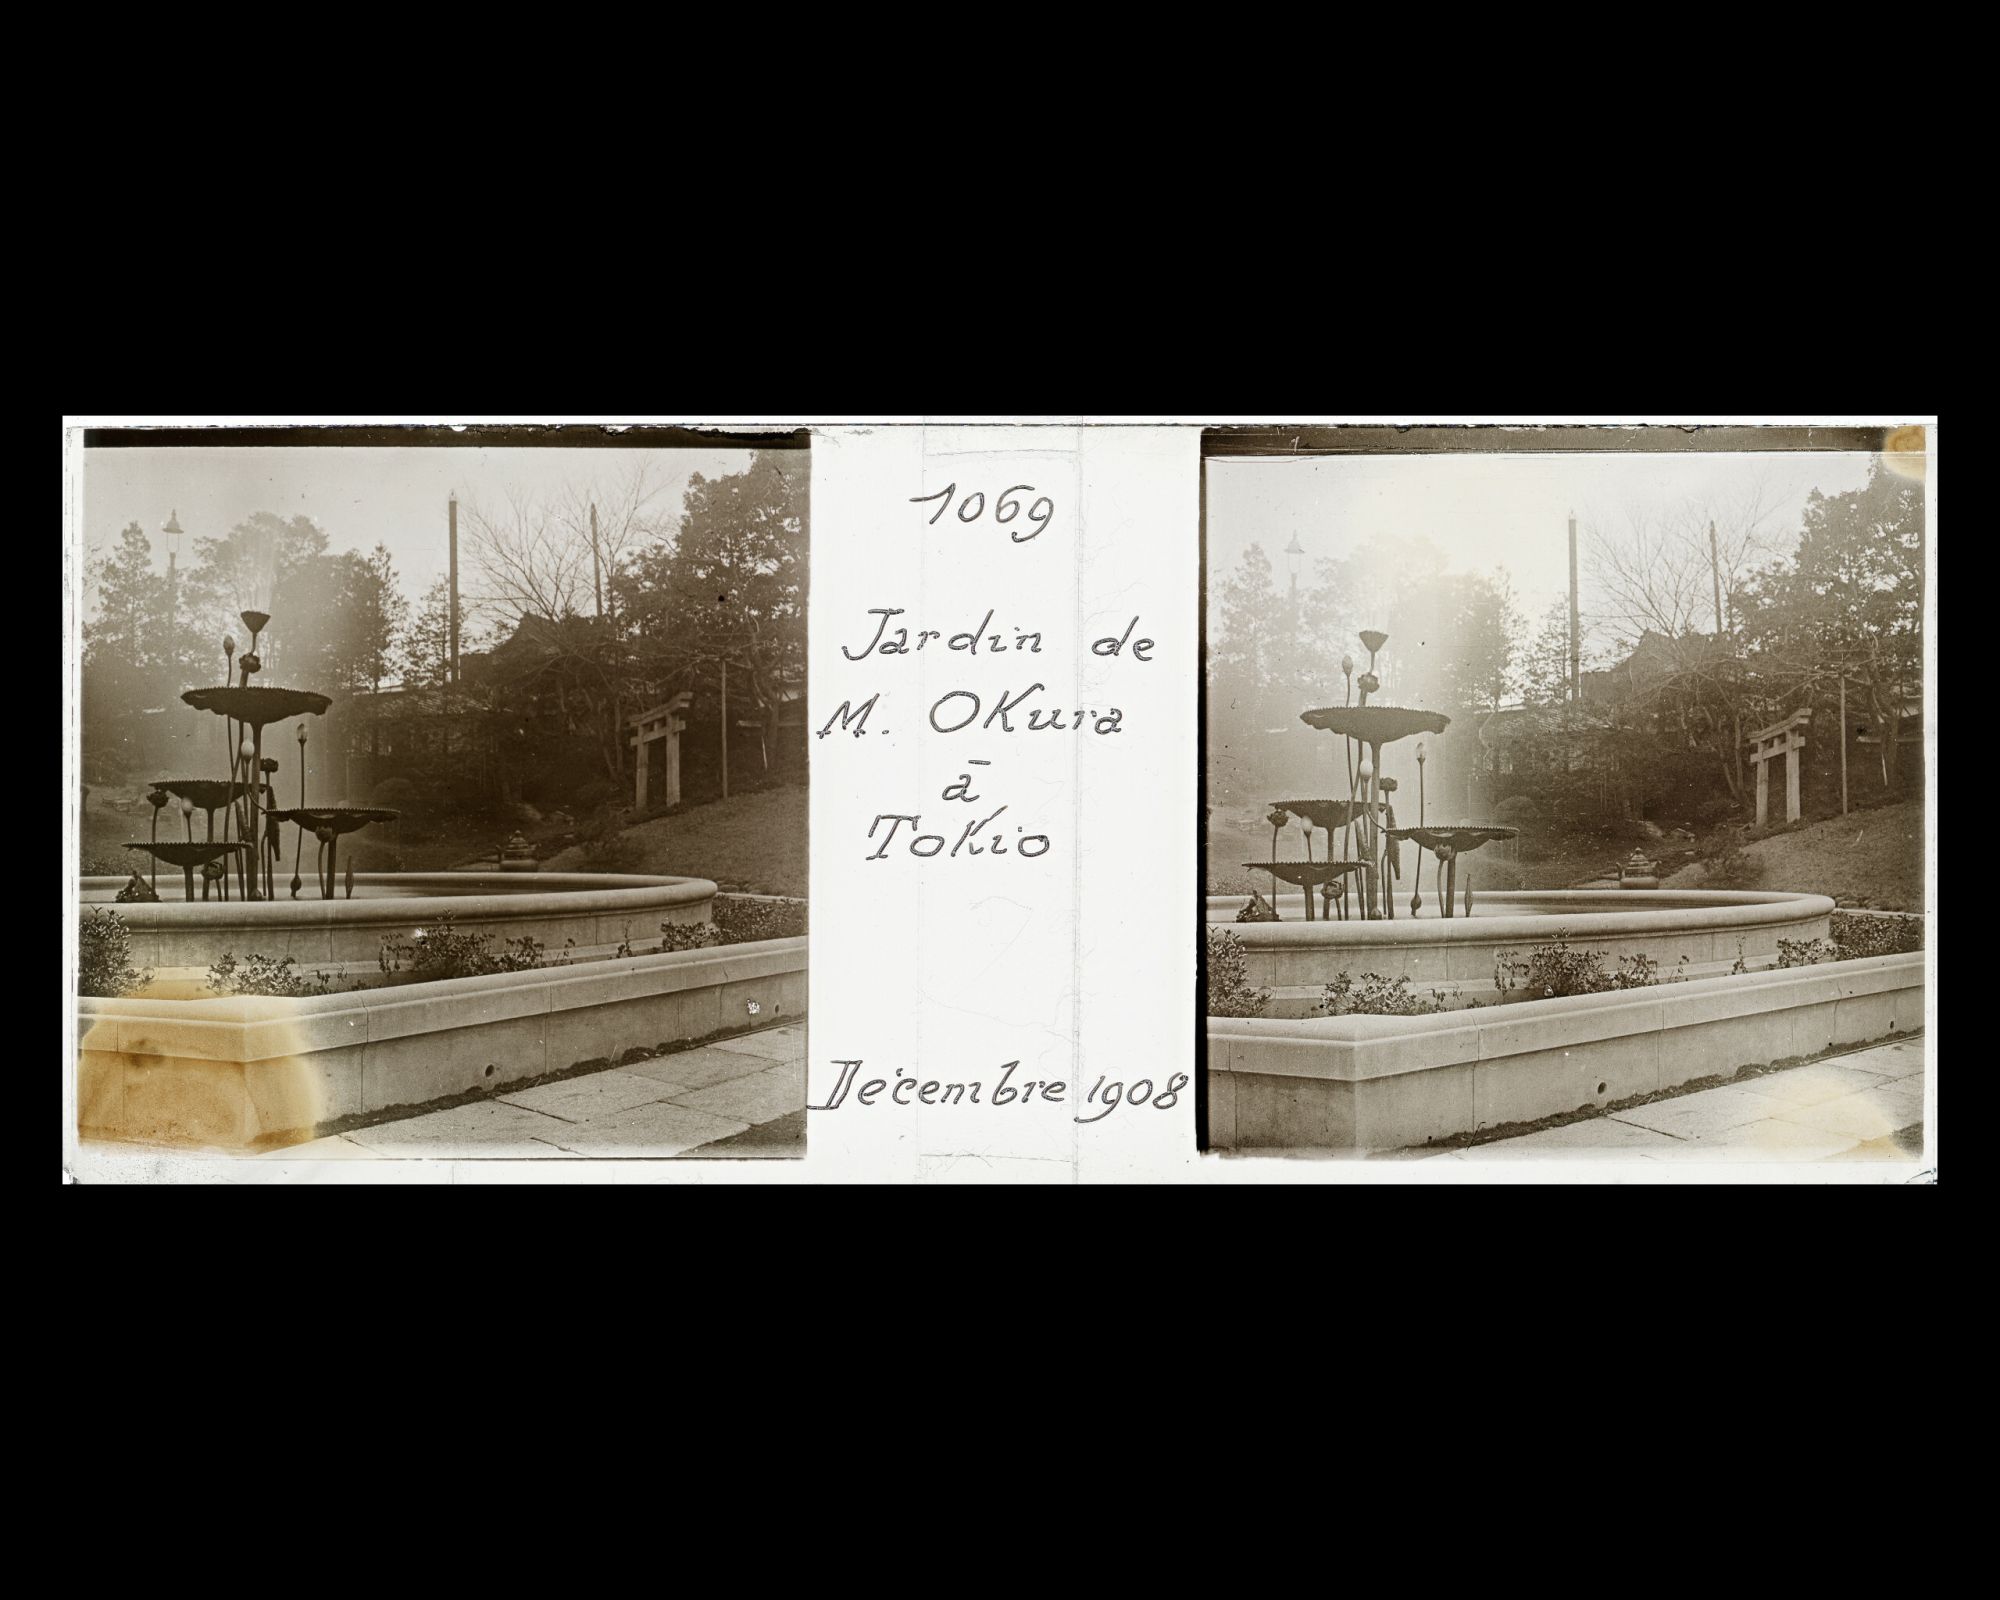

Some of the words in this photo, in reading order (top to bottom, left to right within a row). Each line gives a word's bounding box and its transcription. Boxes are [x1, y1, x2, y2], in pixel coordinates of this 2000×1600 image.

[909, 483, 1055, 543] 1069
[841, 608, 1043, 662] Jardin
[1091, 616, 1155, 662] de
[816, 692, 890, 739] M.
[1073, 1072, 1189, 1123] 1908
